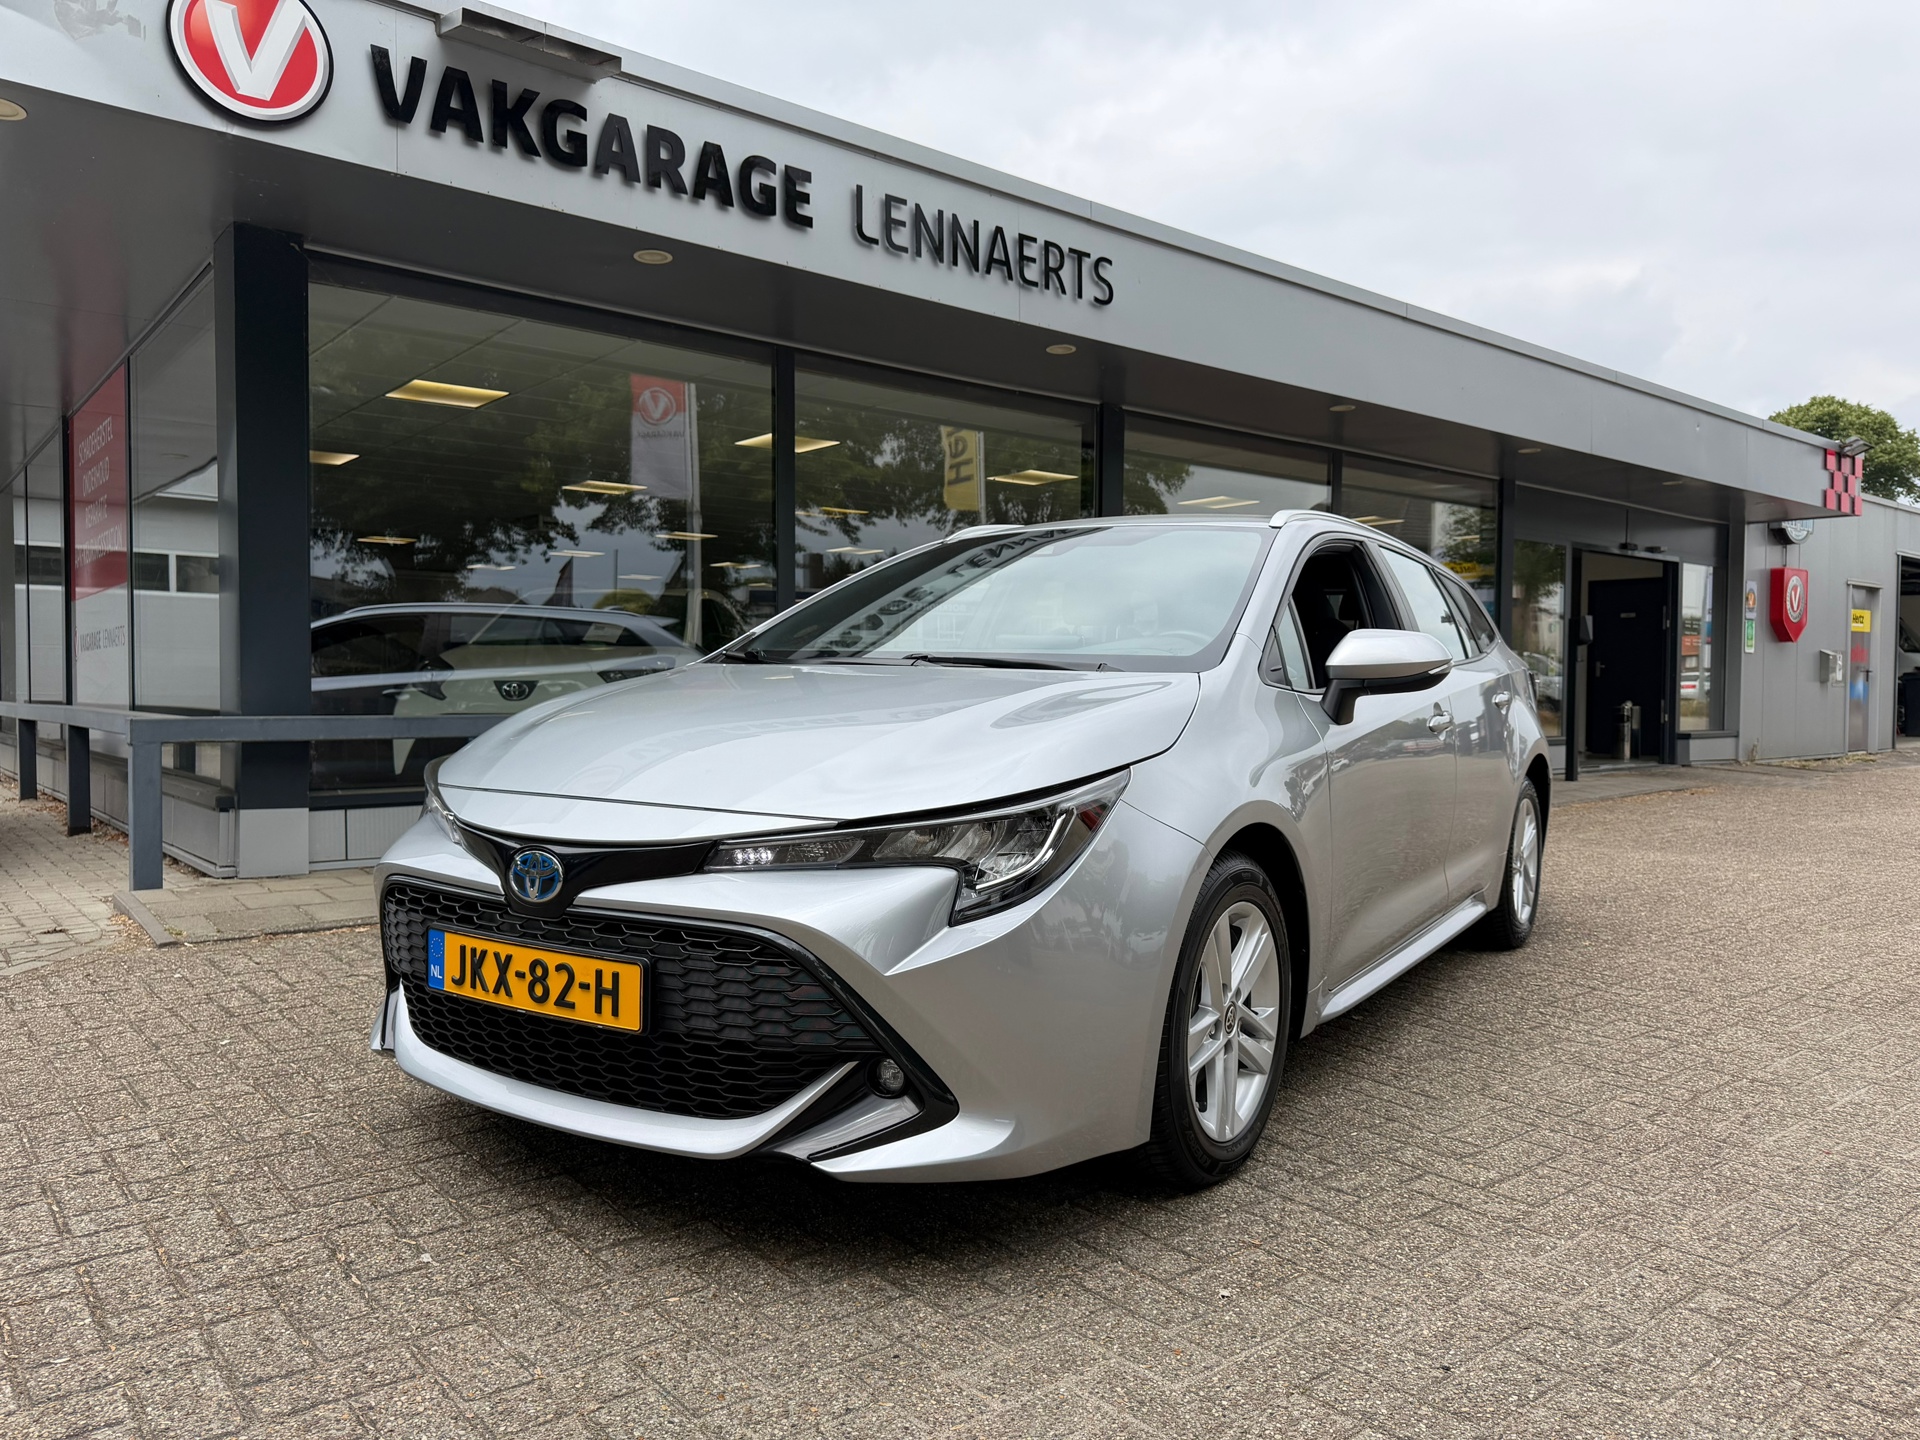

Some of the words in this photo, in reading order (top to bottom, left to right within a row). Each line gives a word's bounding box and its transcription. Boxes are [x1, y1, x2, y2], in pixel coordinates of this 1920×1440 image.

[205, 0, 307, 101] V
[370, 43, 814, 229] VAKGARAGE
[854, 183, 1115, 307] LENNAERTS
[1852, 613, 1865, 624] Hertz
[430, 963, 443, 979] NL
[451, 943, 620, 1018] JKX-82-H
